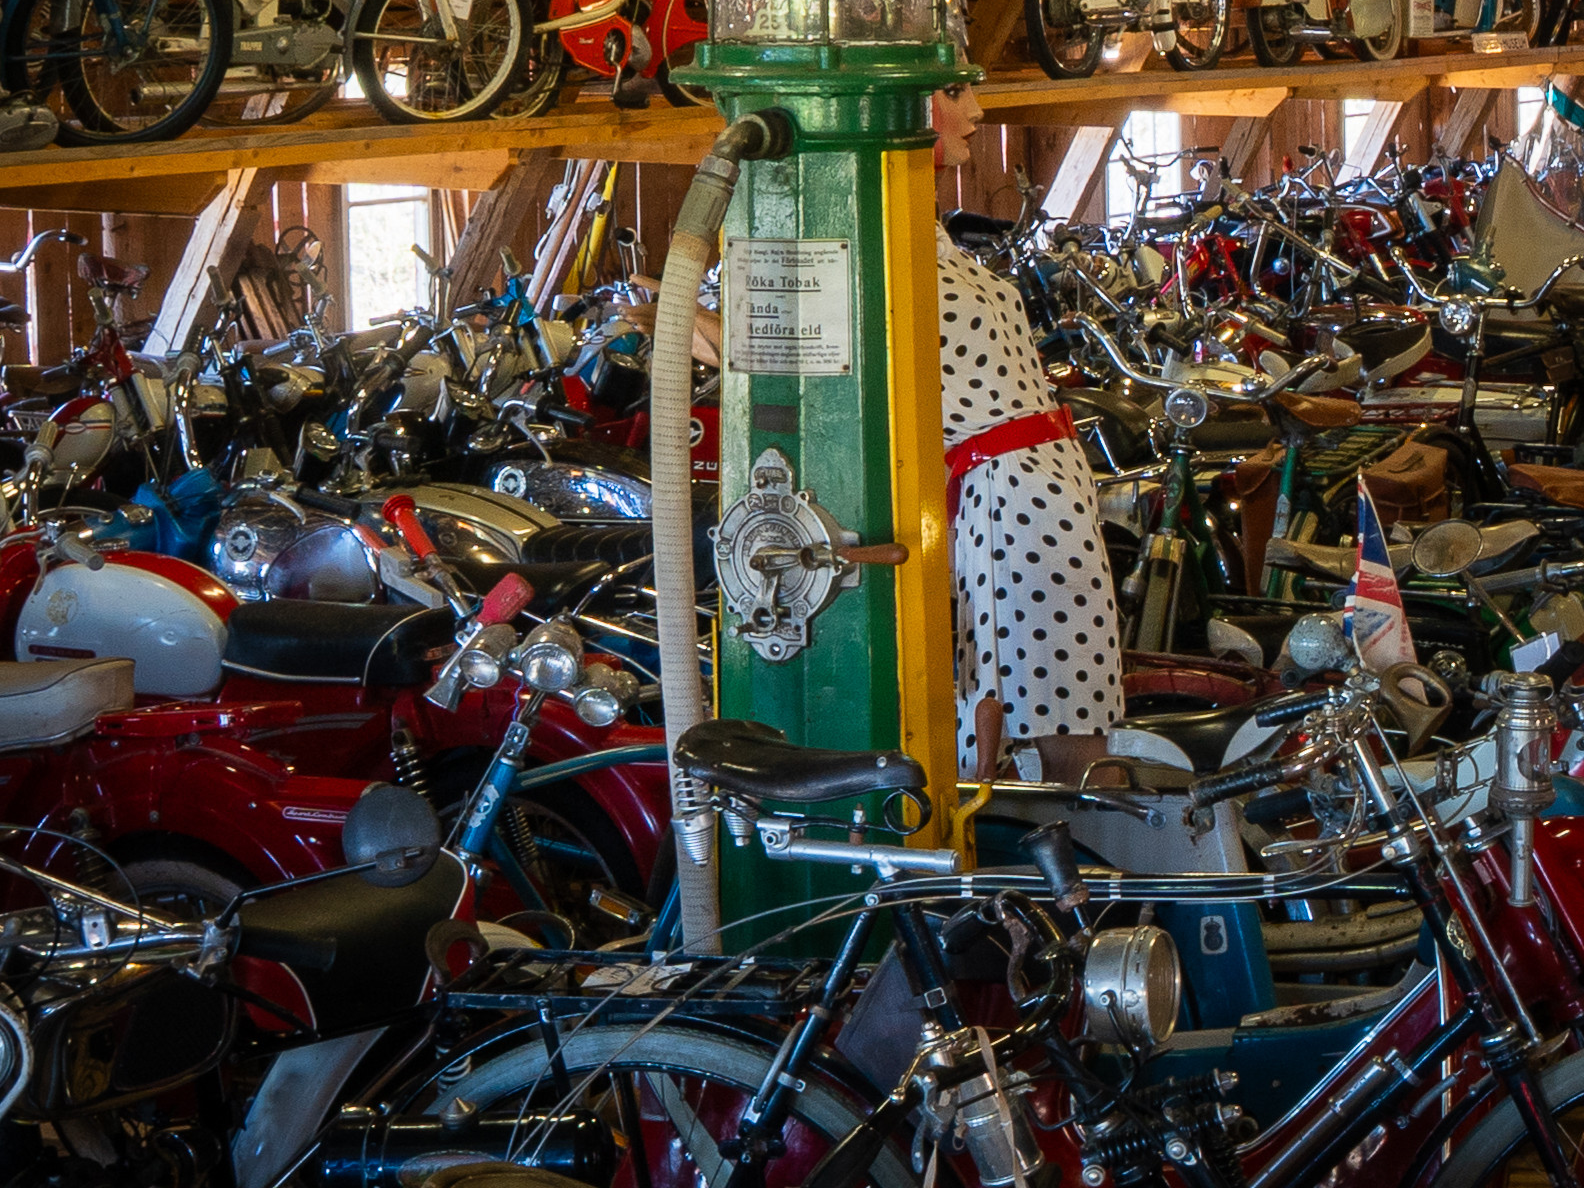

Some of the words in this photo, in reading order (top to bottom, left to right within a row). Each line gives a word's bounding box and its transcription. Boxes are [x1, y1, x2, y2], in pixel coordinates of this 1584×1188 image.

[759, 14, 781, 30] 25
[746, 275, 774, 287] Röka
[780, 276, 820, 288] Tobak
[801, 324, 821, 335] eld
